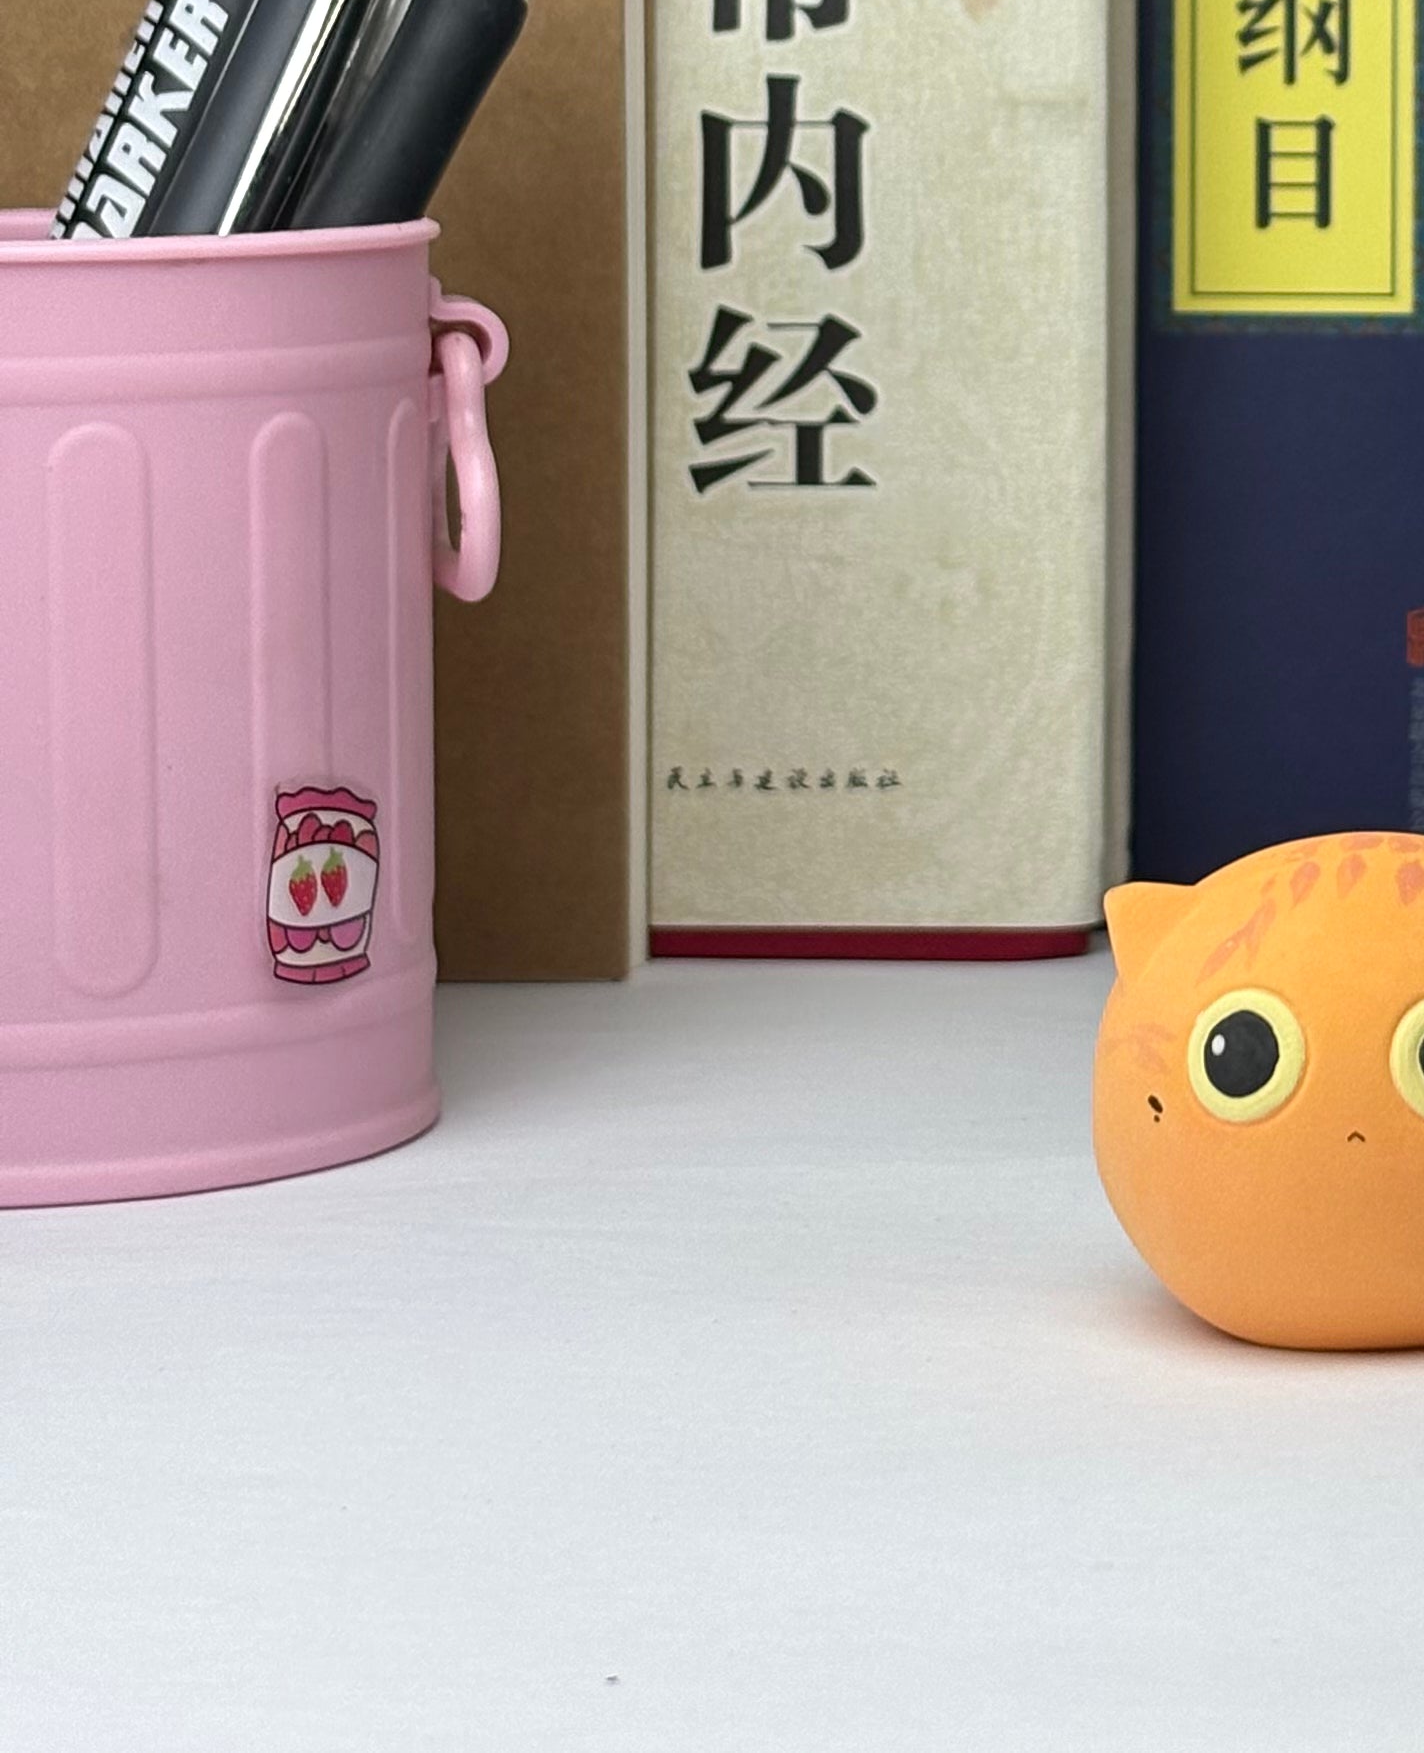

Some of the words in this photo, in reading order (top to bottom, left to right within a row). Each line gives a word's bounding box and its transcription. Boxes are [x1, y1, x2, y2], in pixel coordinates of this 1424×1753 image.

[666, 766, 903, 791] 民主与建设出版社
